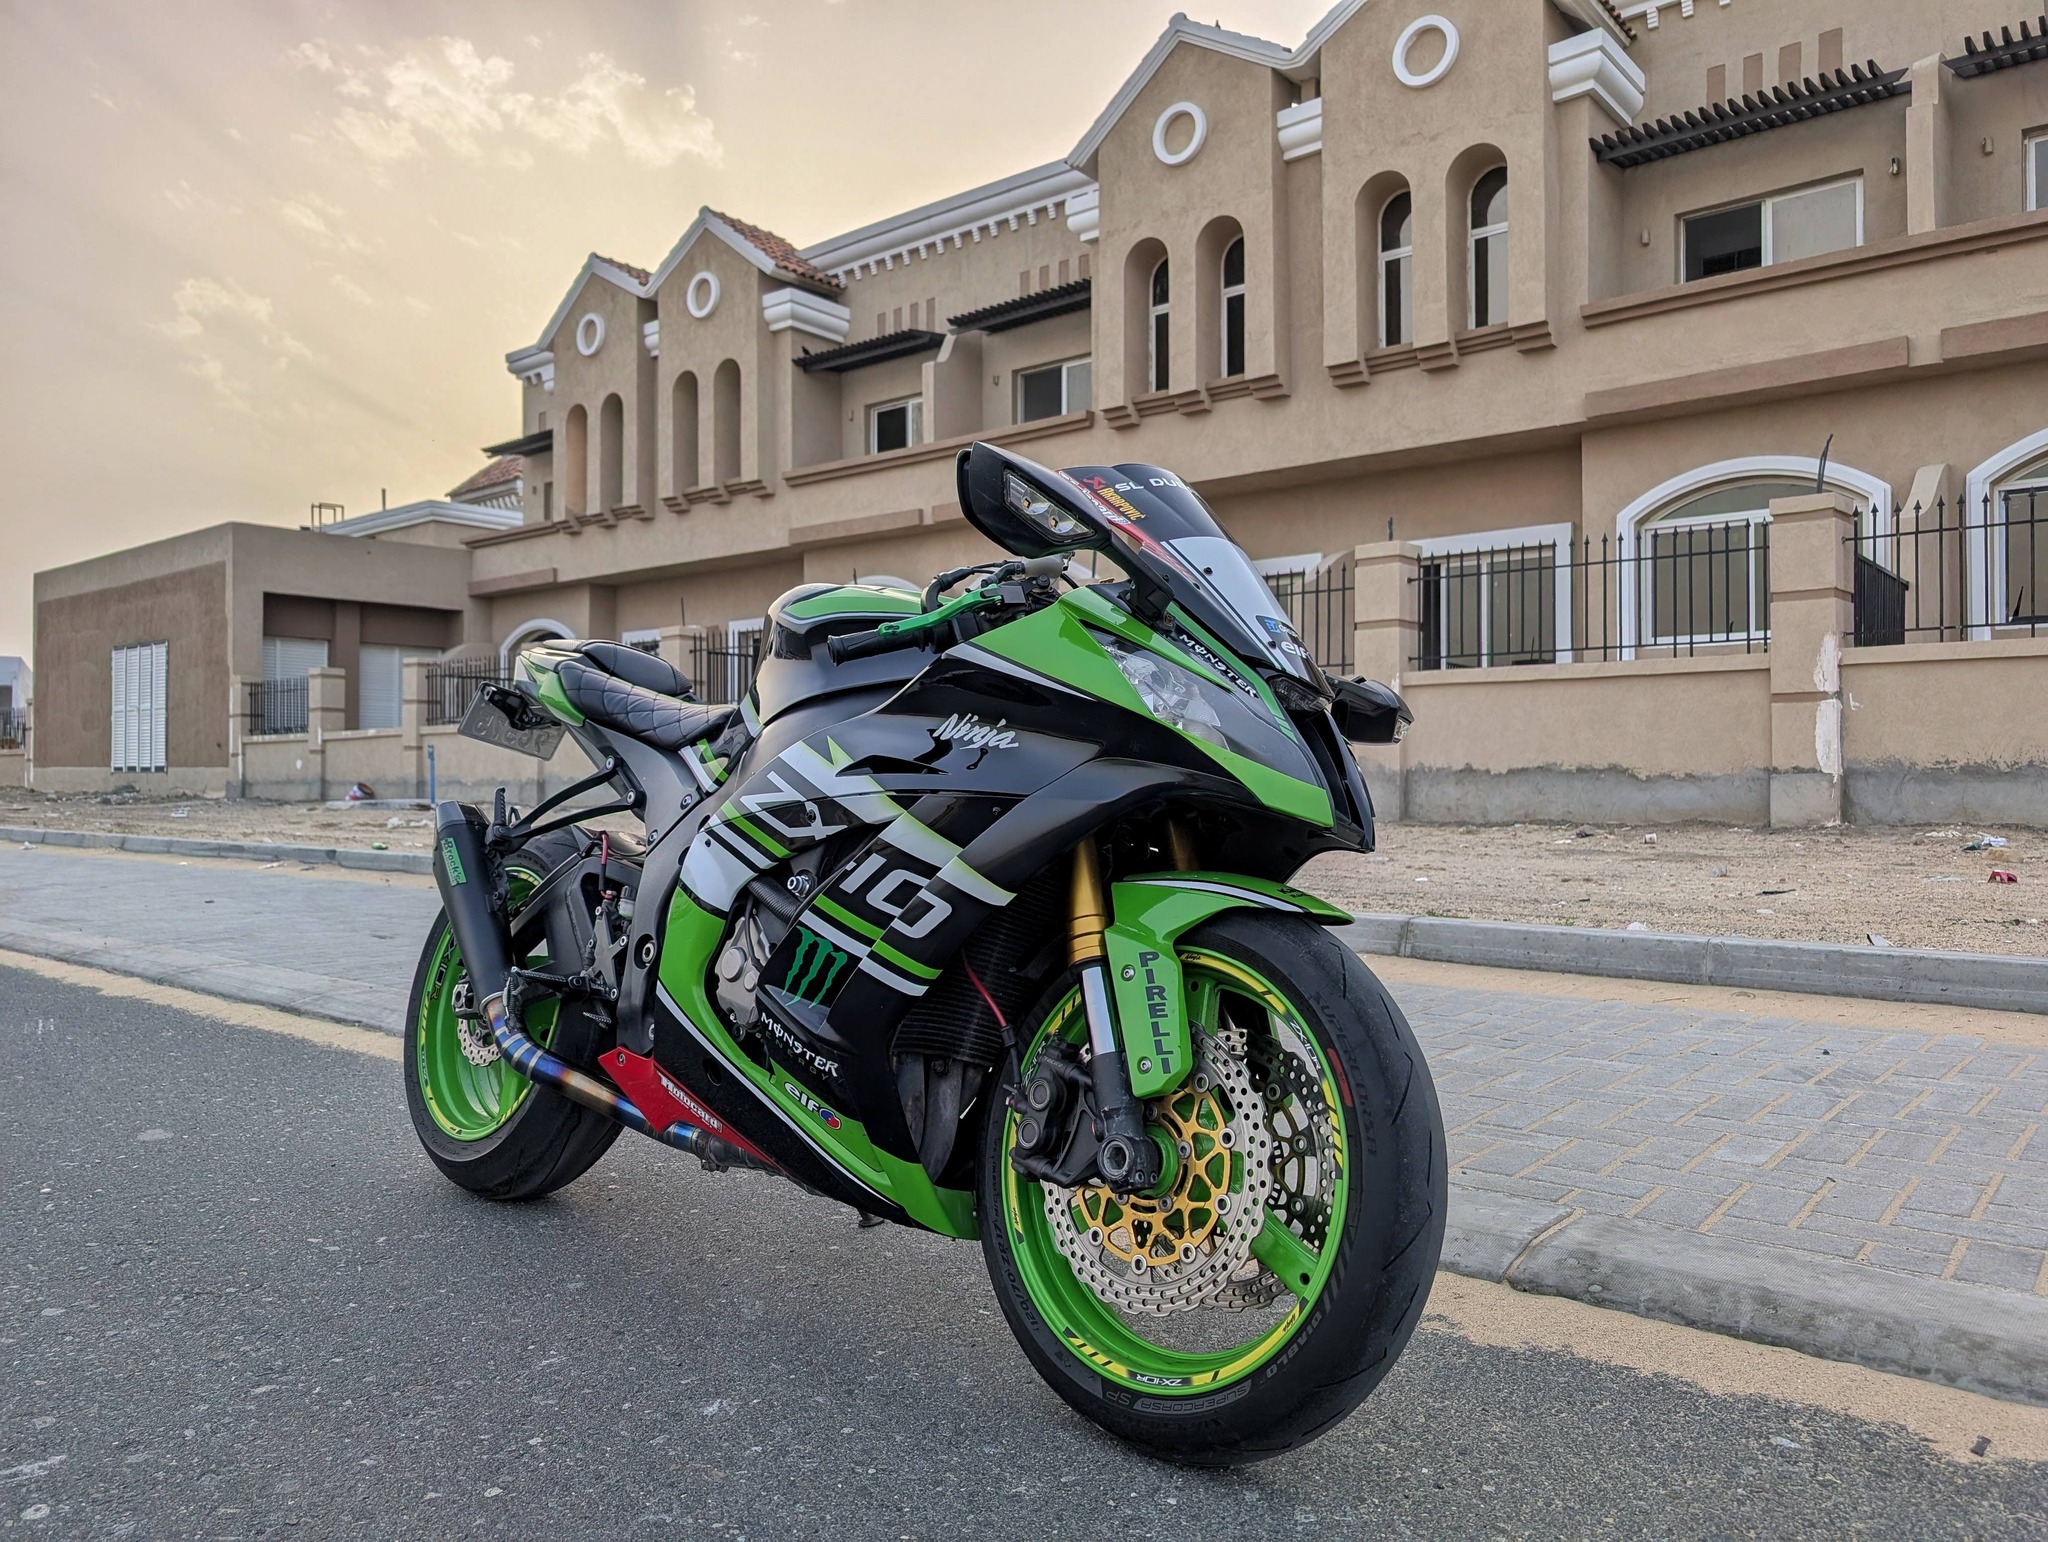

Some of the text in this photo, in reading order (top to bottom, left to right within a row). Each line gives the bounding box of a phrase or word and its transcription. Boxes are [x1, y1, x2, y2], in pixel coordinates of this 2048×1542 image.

[1114, 481, 1144, 492] SL
[1179, 634, 1259, 698] MONSTER
[932, 713, 1019, 750] Ninja
[1138, 951, 1174, 1075] PIRELLI
[761, 1012, 840, 1077] MONSTER
[1290, 1020, 1321, 1070] ZX-10R
[1266, 1311, 1322, 1379] DIABLO
[1106, 1384, 1249, 1413] SUPERCORSA SP
[1136, 1373, 1183, 1387] ZX-10R
